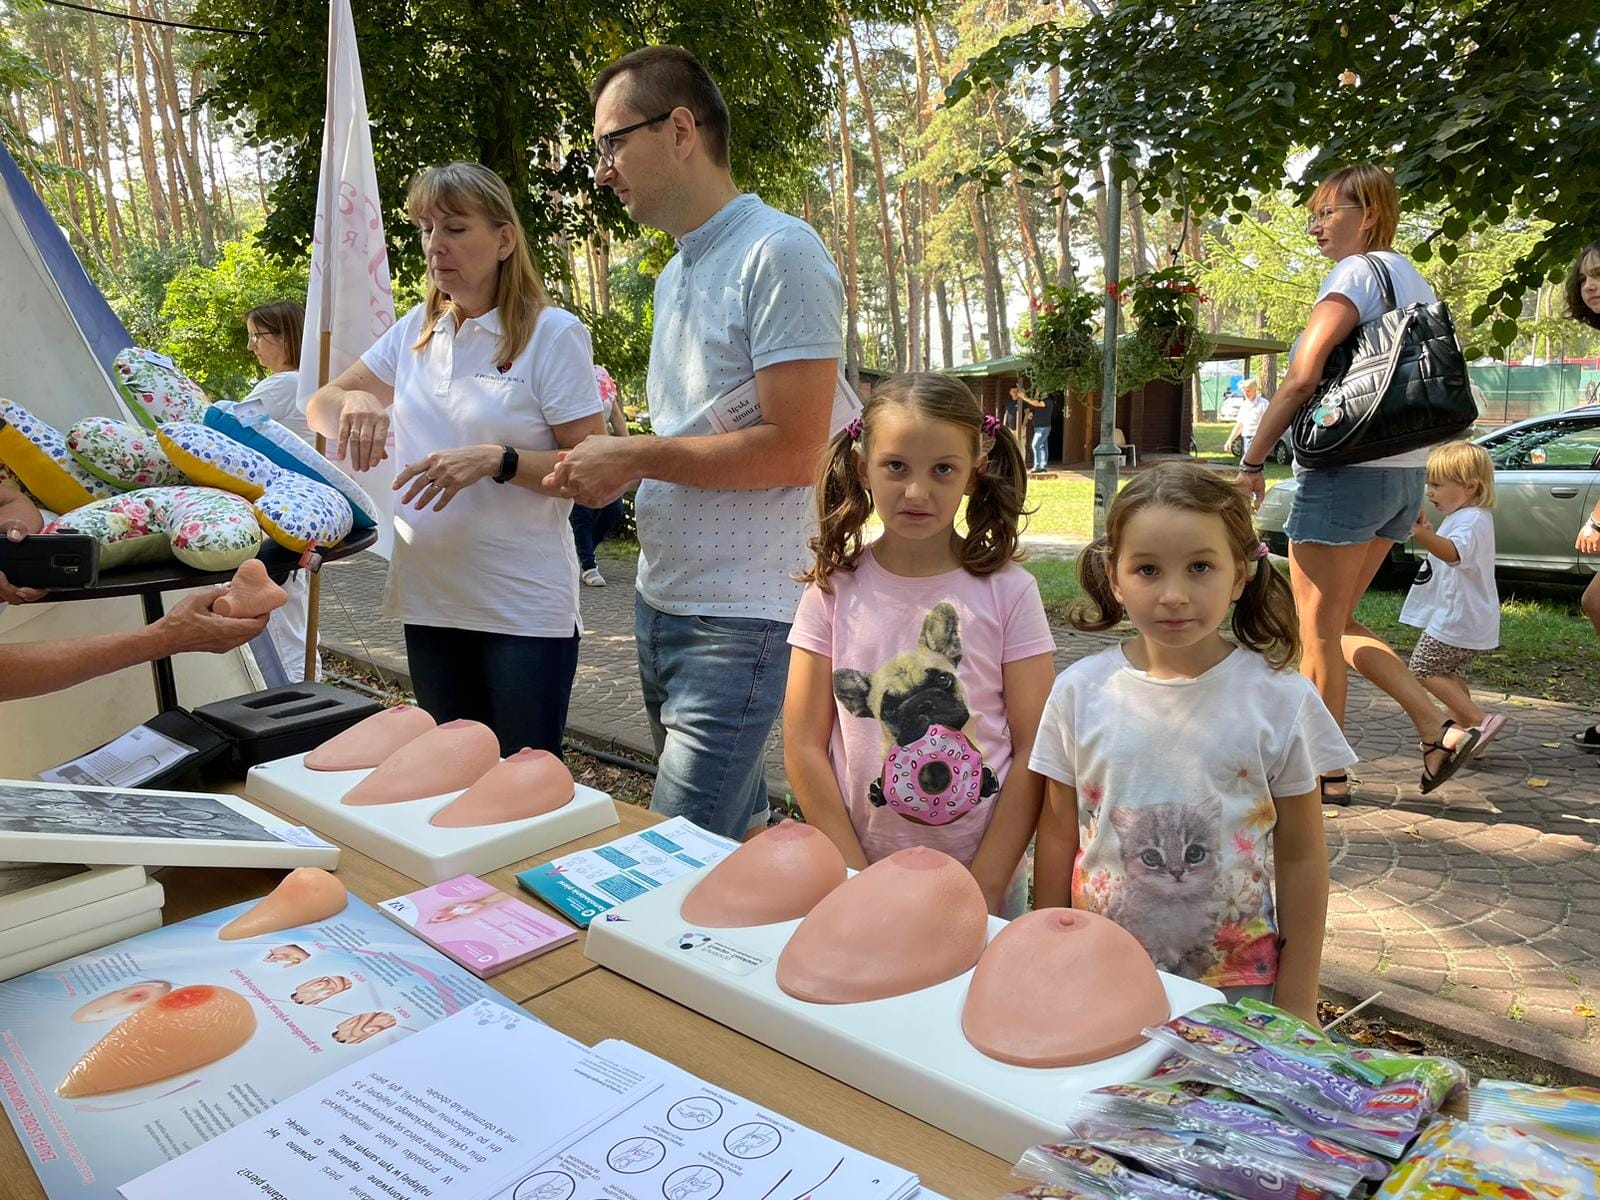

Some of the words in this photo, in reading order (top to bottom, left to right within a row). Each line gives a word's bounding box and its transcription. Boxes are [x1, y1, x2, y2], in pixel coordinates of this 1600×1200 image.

[727, 399, 750, 416] Męska
[732, 407, 755, 424] strona
[446, 1101, 464, 1112] lub
[1372, 1093, 1418, 1105] LEGO
[316, 1096, 376, 1132] miesiączkujących
[355, 1101, 398, 1126] wykonywać
[390, 1104, 451, 1140] miesiączkowego
[457, 1108, 498, 1132] obrzmiałe
[20, 1112, 41, 1137] SOBIE
[262, 1126, 283, 1138] być
[389, 1122, 407, 1132] się
[433, 1112, 478, 1138] skończeniu
[492, 1127, 507, 1136] są
[311, 1137, 325, 1146] co
[371, 1131, 401, 1149] kobiet
[399, 1129, 426, 1145] zaleca
[444, 1136, 471, 1152] cyklu
[474, 1134, 490, 1144] po
[500, 1133, 518, 1144] nie
[282, 1140, 318, 1162] powinno
[352, 1142, 383, 1162] samym
[465, 1149, 488, 1163] dniu
[485, 1142, 503, 1153] dni
[324, 1147, 365, 1173] regularnie
[375, 1158, 397, 1171] tym
[398, 1147, 442, 1174] przypadku
[419, 1142, 472, 1174] samobadanie
[234, 1166, 268, 1187] piersi?
[317, 1165, 344, 1182] piersi
[390, 1168, 403, 1176] w
[439, 1174, 455, 1184] W
[257, 1183, 290, 1200] danie
[345, 1185, 376, 1200] danie
[396, 1172, 435, 1197] najlepiej
